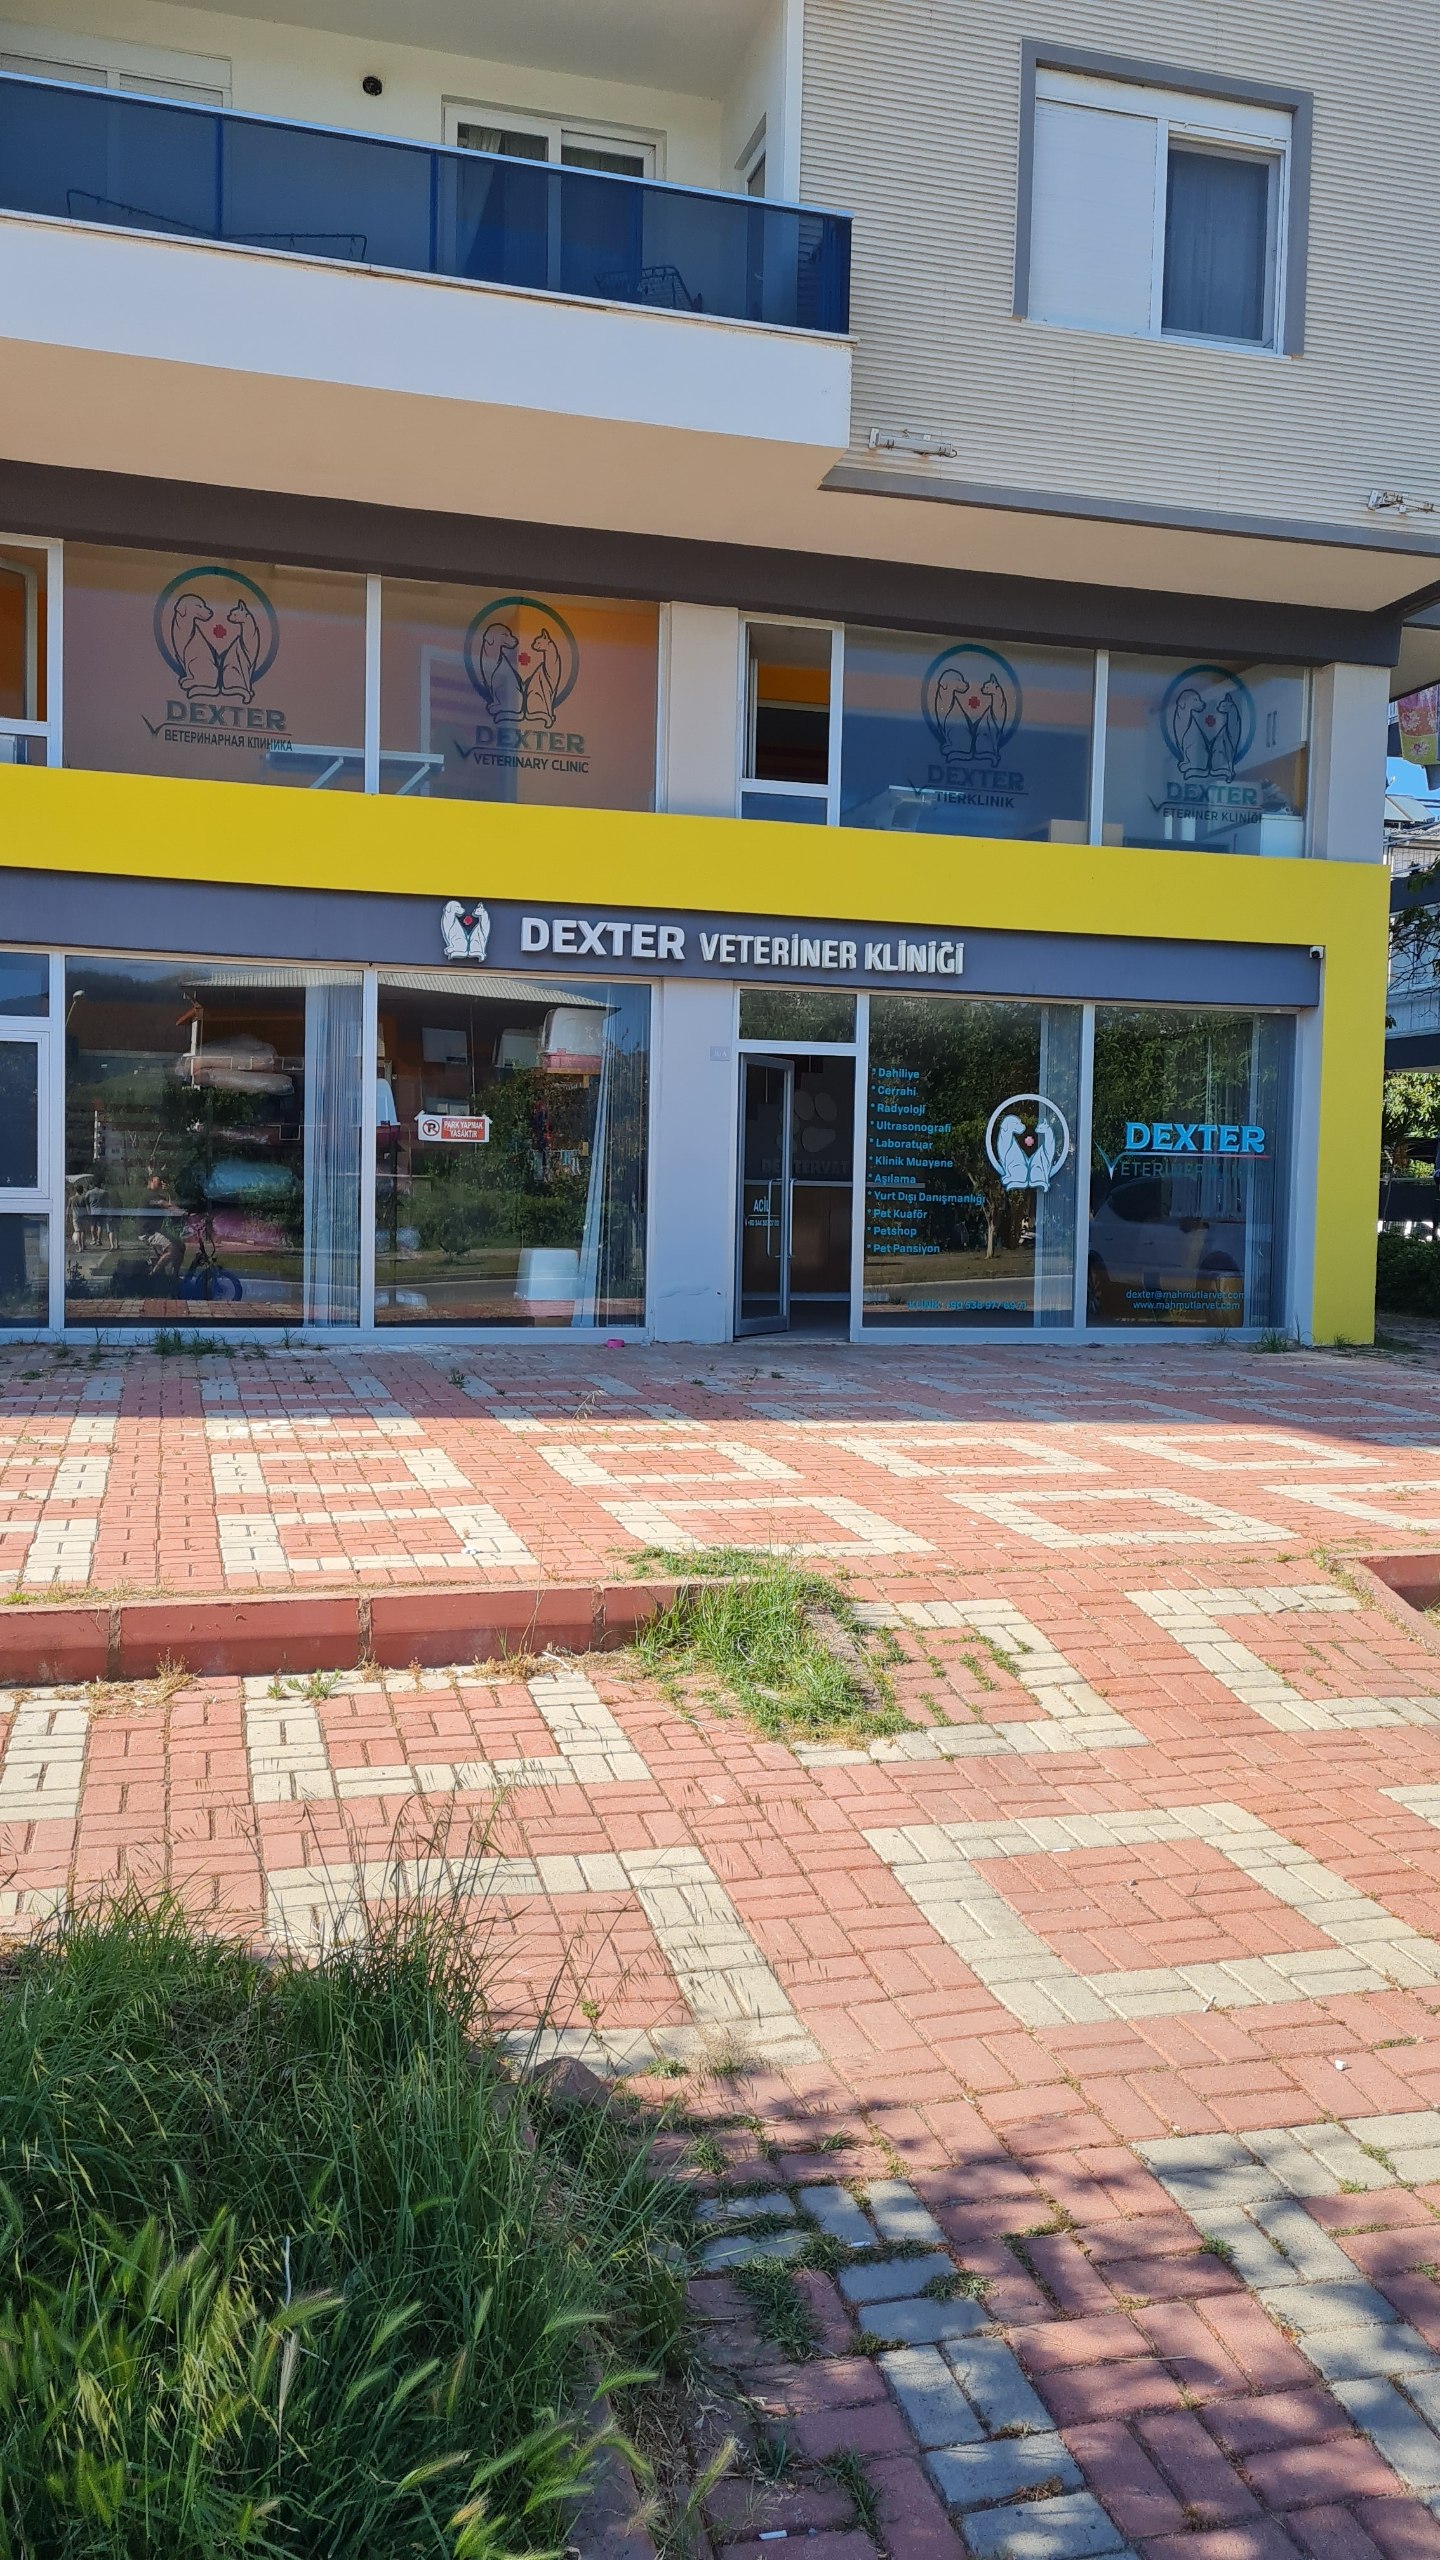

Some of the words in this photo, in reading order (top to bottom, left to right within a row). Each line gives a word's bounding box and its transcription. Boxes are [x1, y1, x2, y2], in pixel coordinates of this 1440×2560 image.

[165, 700, 287, 731] DEXTER
[164, 729, 245, 748] ВЕТЕРИНАРНАЯ
[247, 737, 293, 752] КЛИНИКА
[475, 725, 585, 754] DEXTER
[474, 752, 549, 770] VETERINARY
[551, 759, 589, 774] CLINIC
[927, 764, 1025, 792] DEXTER
[935, 791, 1015, 809] TIERKLINIK
[1166, 781, 1257, 805] DEXTER
[520, 917, 686, 960] DEXTER
[699, 932, 857, 970] VETERİNER
[864, 939, 965, 975] KLİNİĞİ
[878, 1067, 920, 1081] Dahiliye
[877, 1085, 917, 1096] Cerrahi
[877, 1103, 926, 1117] Radyoloji
[443, 1120, 460, 1130] PARK
[460, 1121, 484, 1131] YAPMAK
[876, 1120, 952, 1134] Ultrasonografi
[875, 1138, 934, 1150] Laboratuar
[1124, 1121, 1266, 1154] DEXTER
[875, 1155, 905, 1166] Klinik
[906, 1157, 954, 1169] Muayene
[874, 1173, 917, 1186] Aşılama
[874, 1190, 896, 1201] Yurt
[898, 1191, 917, 1204] Dışı
[918, 1192, 986, 1206] Danışmanlığı
[873, 1208, 891, 1218] Pet
[893, 1208, 928, 1219] Kuaför
[873, 1226, 918, 1238] Petshop
[873, 1243, 891, 1253] Pet
[893, 1244, 940, 1256] Pansiyon
[1132, 1301, 1240, 1310] www.mahmutlarvet.com
